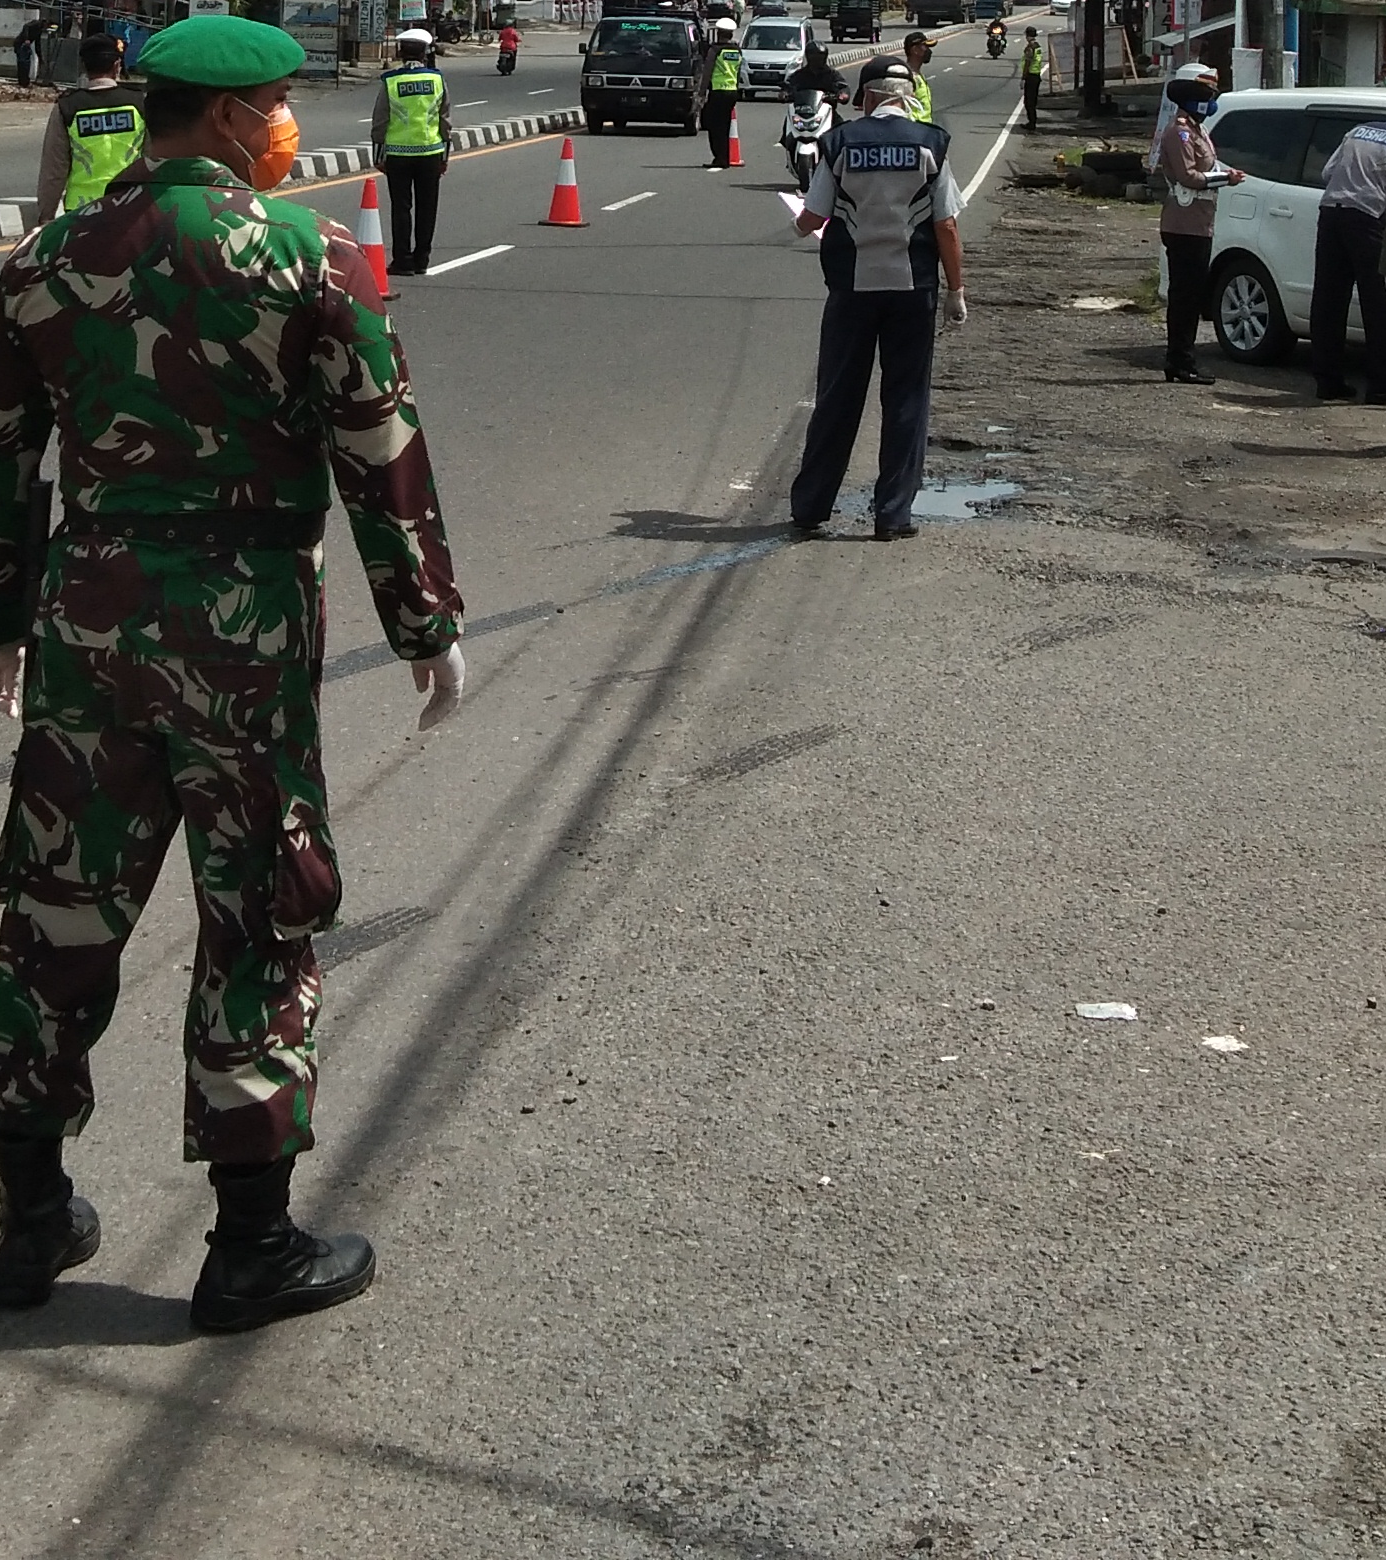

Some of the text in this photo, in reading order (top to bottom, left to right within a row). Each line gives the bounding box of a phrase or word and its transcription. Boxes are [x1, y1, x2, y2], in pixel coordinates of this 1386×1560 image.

[399, 83, 434, 95] POLISI
[78, 112, 133, 134] POLISI
[849, 146, 917, 168] DISHUB
